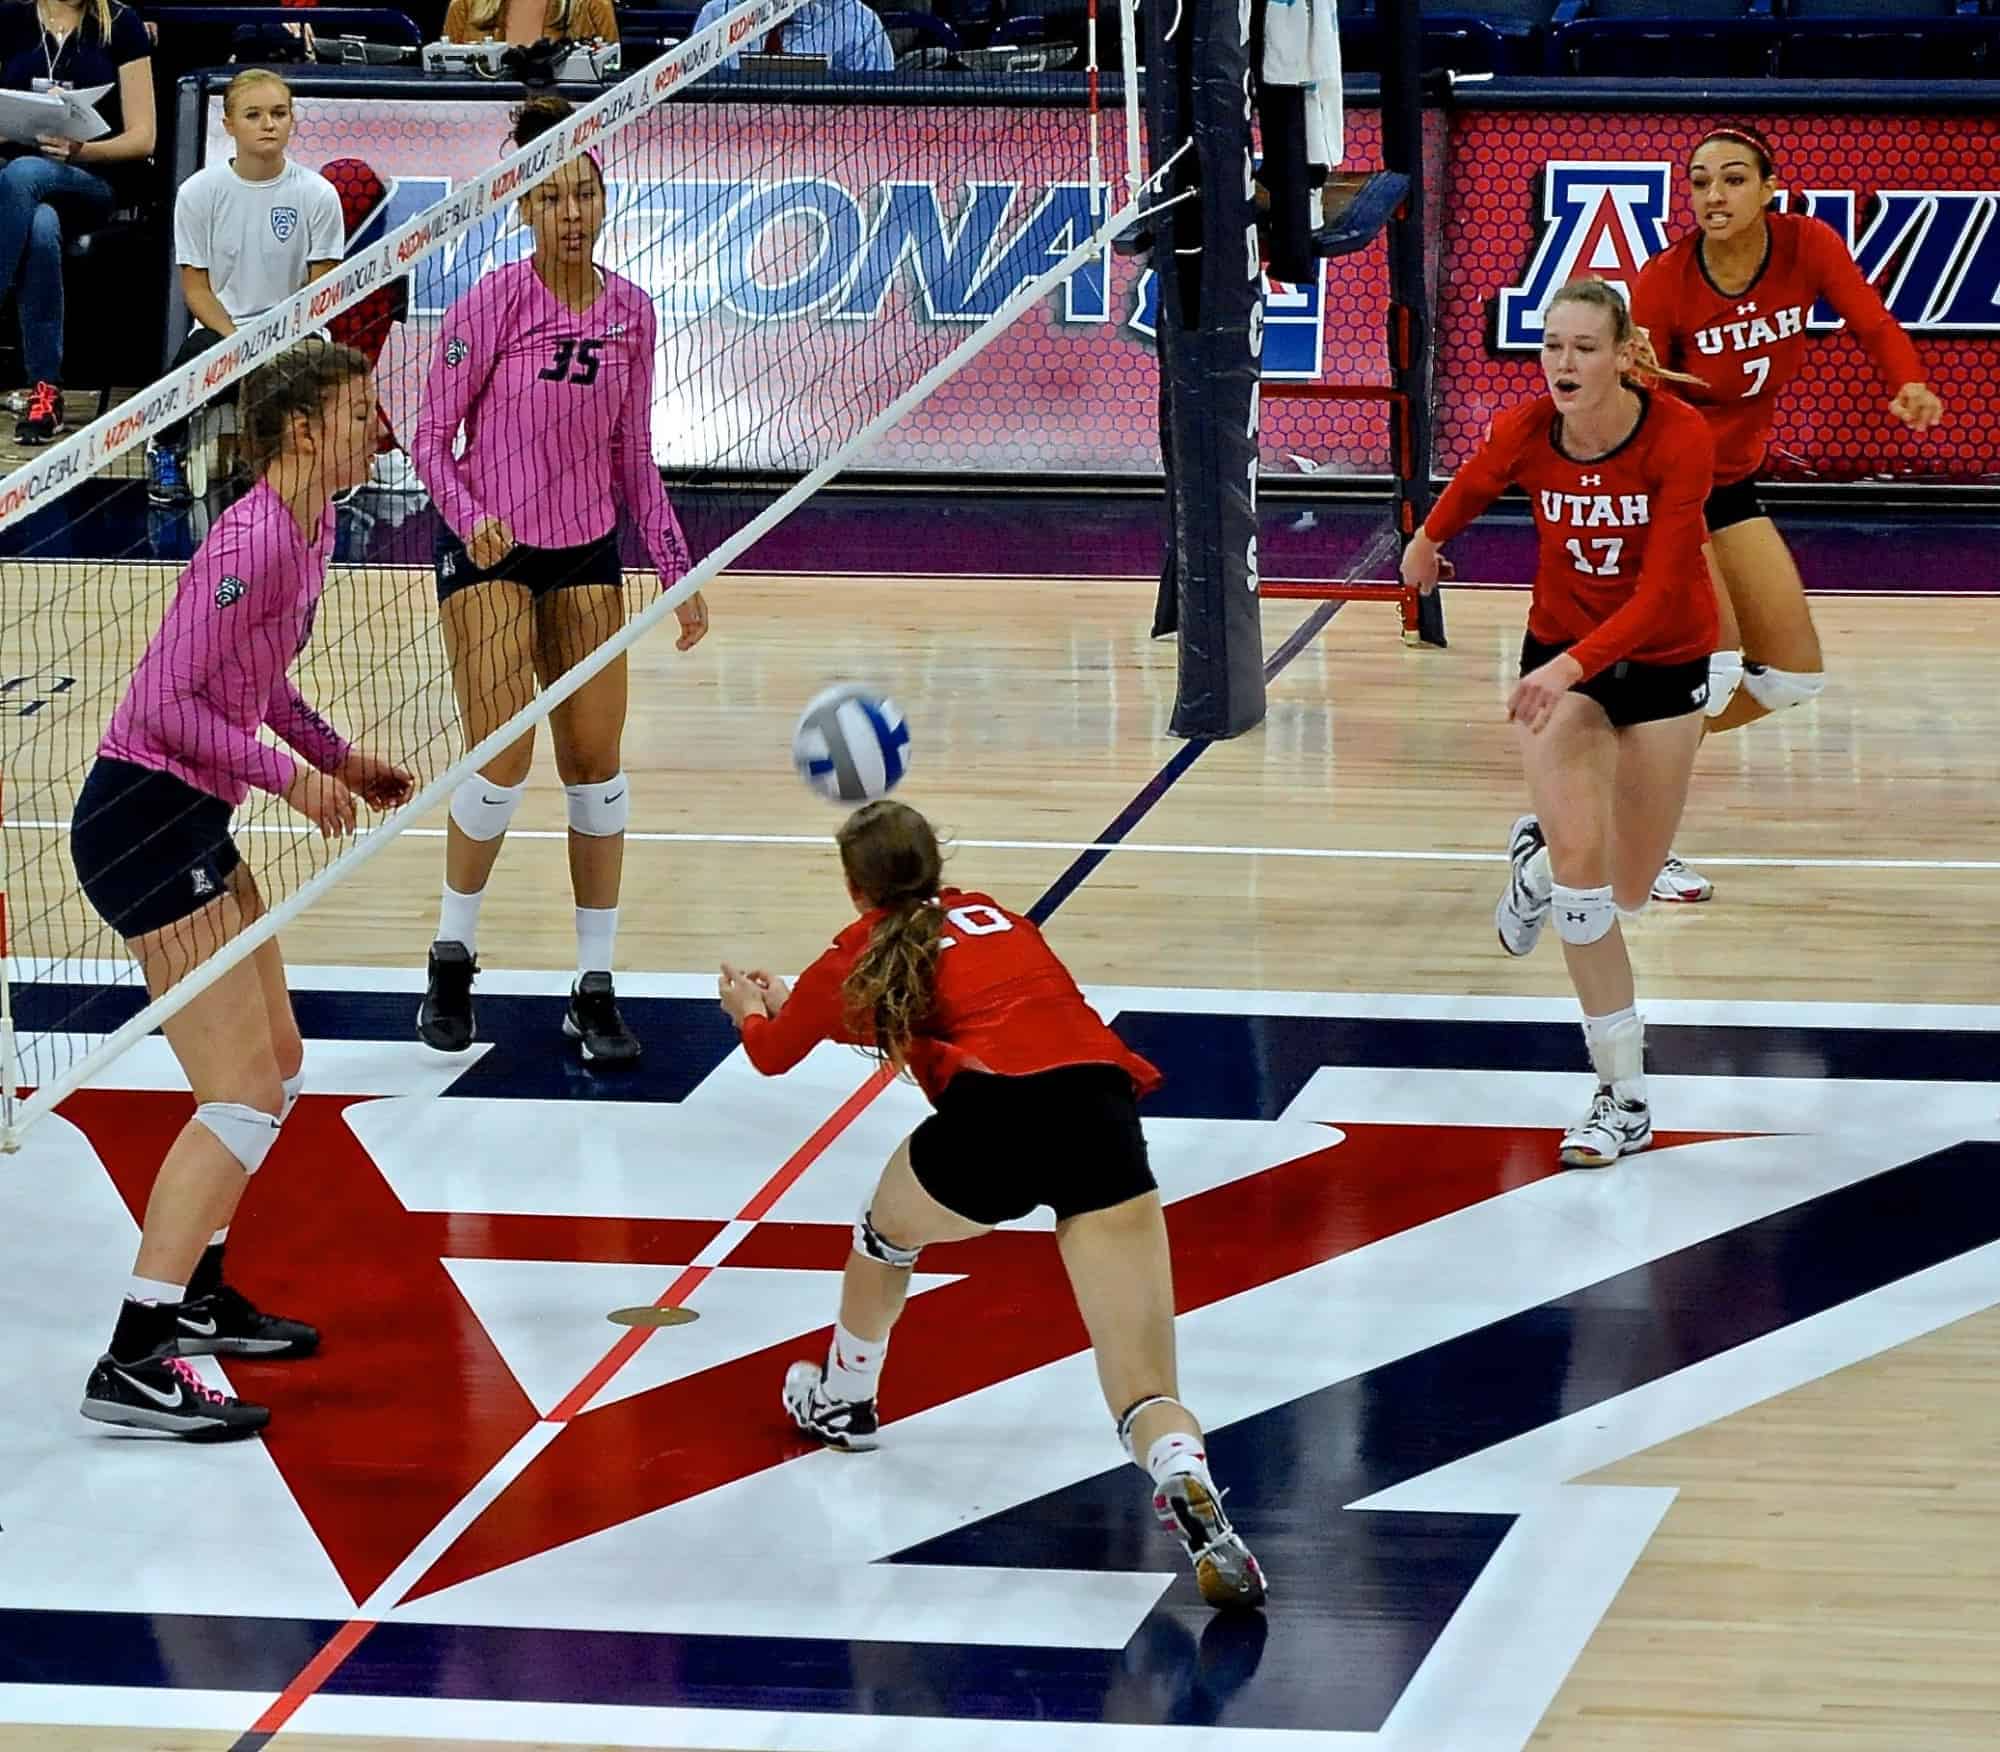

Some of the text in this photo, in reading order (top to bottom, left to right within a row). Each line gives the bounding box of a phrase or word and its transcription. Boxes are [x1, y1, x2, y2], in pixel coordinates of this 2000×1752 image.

[1695, 307, 1802, 354] UTAH
[538, 339, 604, 386] 35
[1741, 356, 1771, 398] 7
[1541, 490, 1649, 527] UTAH
[1566, 537, 1623, 576] 17
